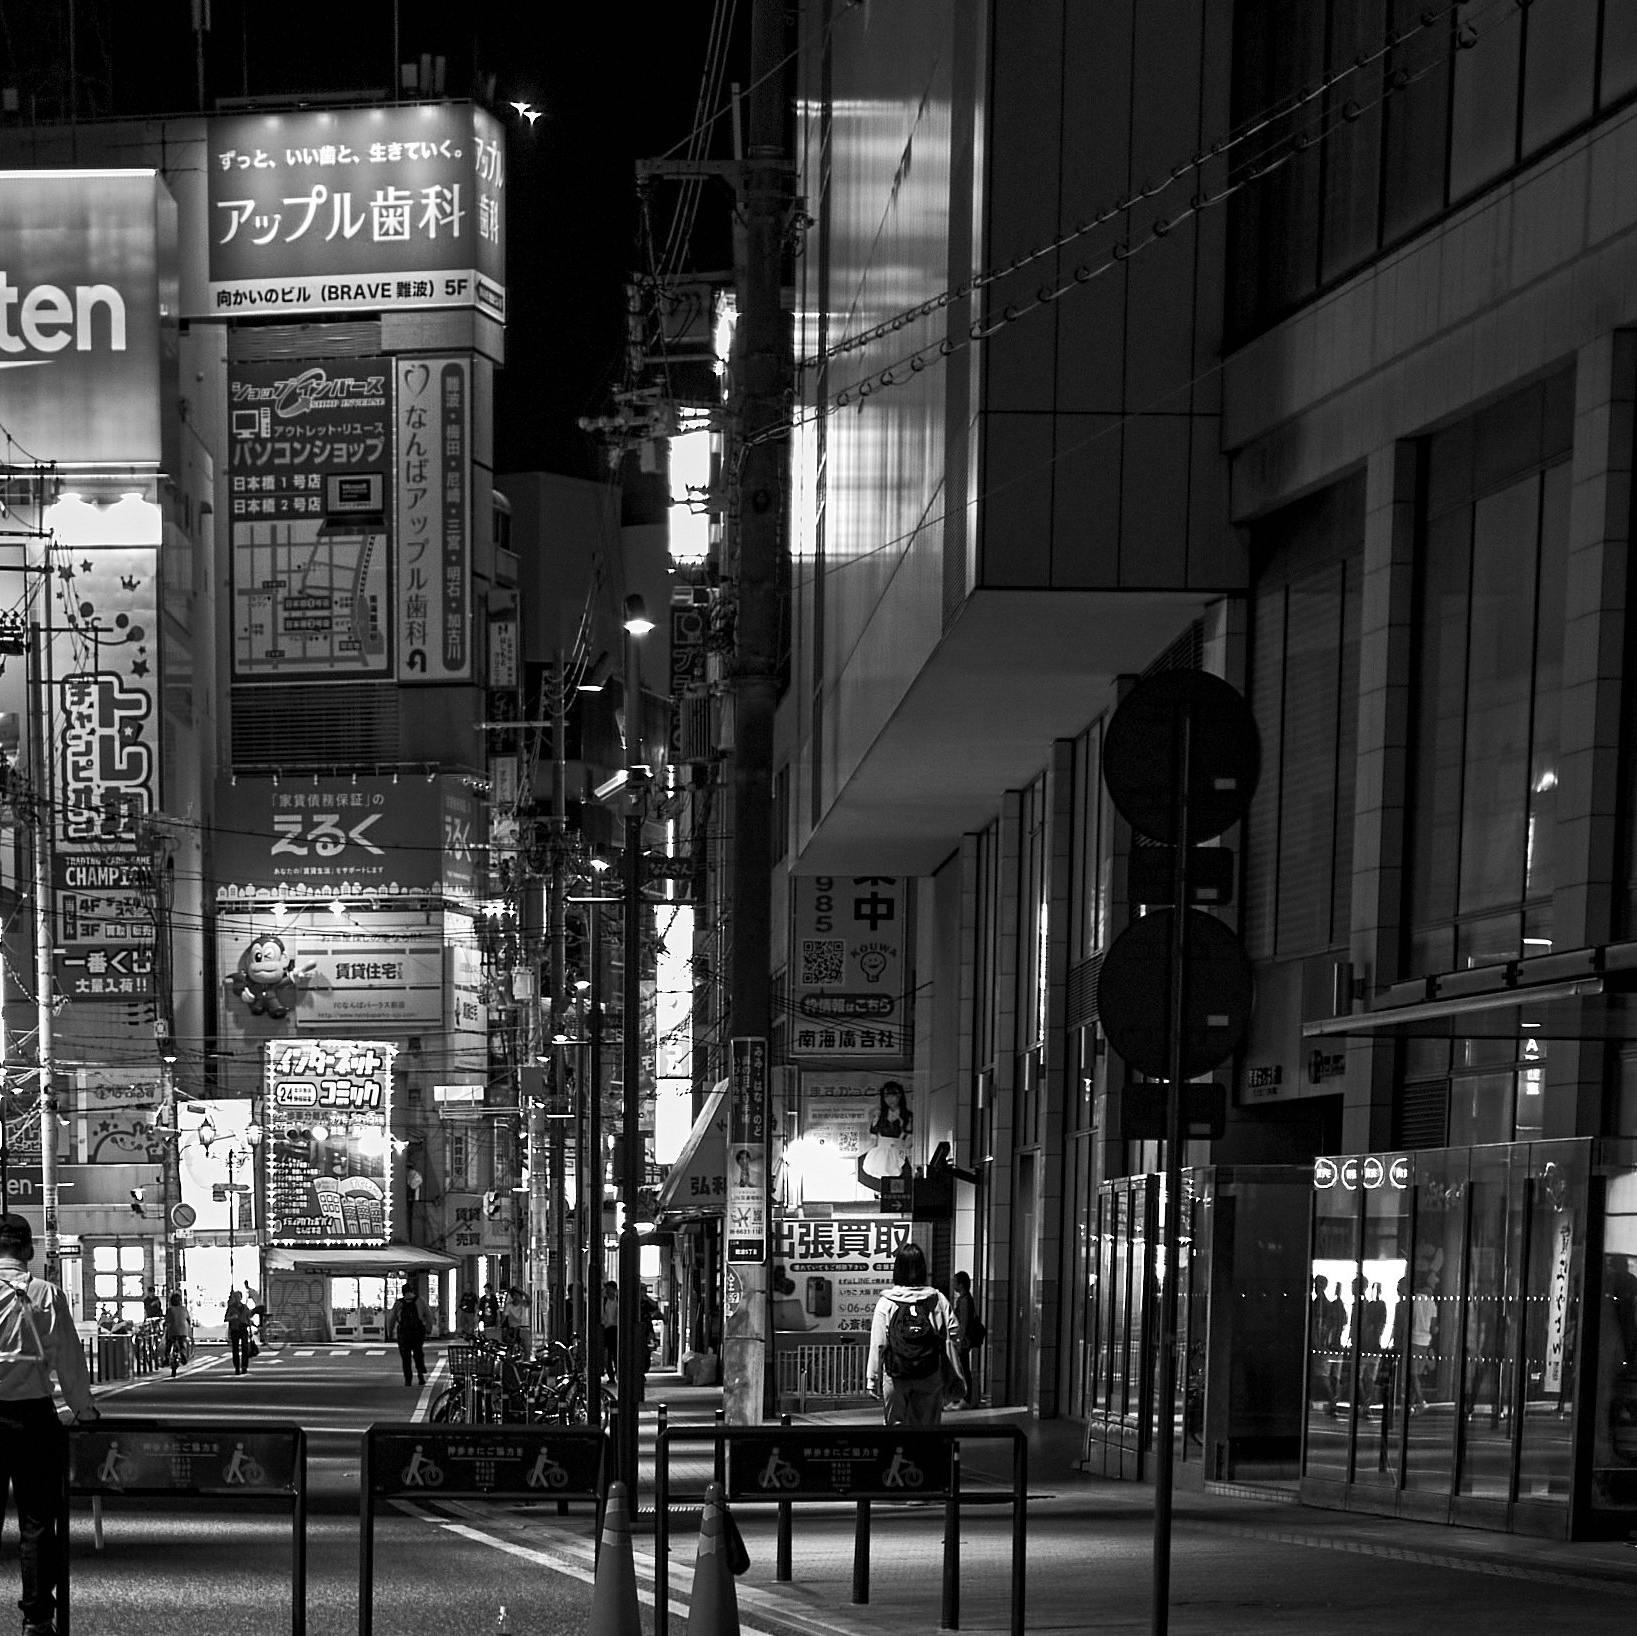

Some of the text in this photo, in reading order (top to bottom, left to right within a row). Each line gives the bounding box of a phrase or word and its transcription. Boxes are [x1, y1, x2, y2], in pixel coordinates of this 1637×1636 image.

[219, 140, 464, 169] ずっと、いい歯と、生きていく。
[474, 136, 503, 189] アップル
[217, 184, 465, 245] アップル歯科
[477, 194, 500, 244] 歯科
[217, 287, 311, 308] 向かいのビル
[445, 280, 469, 297] 5F
[273, 423, 385, 437] アウトレット・リユース
[233, 437, 386, 465] パソコンショップ
[405, 404, 430, 646] なんばアップル歯科
[272, 793, 385, 807] 「家賃債務保証」の
[270, 814, 386, 856] えるく
[80, 899, 100, 912] 4F
[853, 877, 896, 930] 中
[80, 923, 100, 936] 3F
[64, 951, 152, 974] 一番くじ
[851, 943, 896, 957] KOUWA
[336, 962, 396, 979] 賃貸住宅
[274, 1047, 382, 1077] インターネット
[280, 1087, 293, 1102] 24
[319, 1079, 382, 1109] コミック
[772, 1222, 910, 1259] 出張買取
